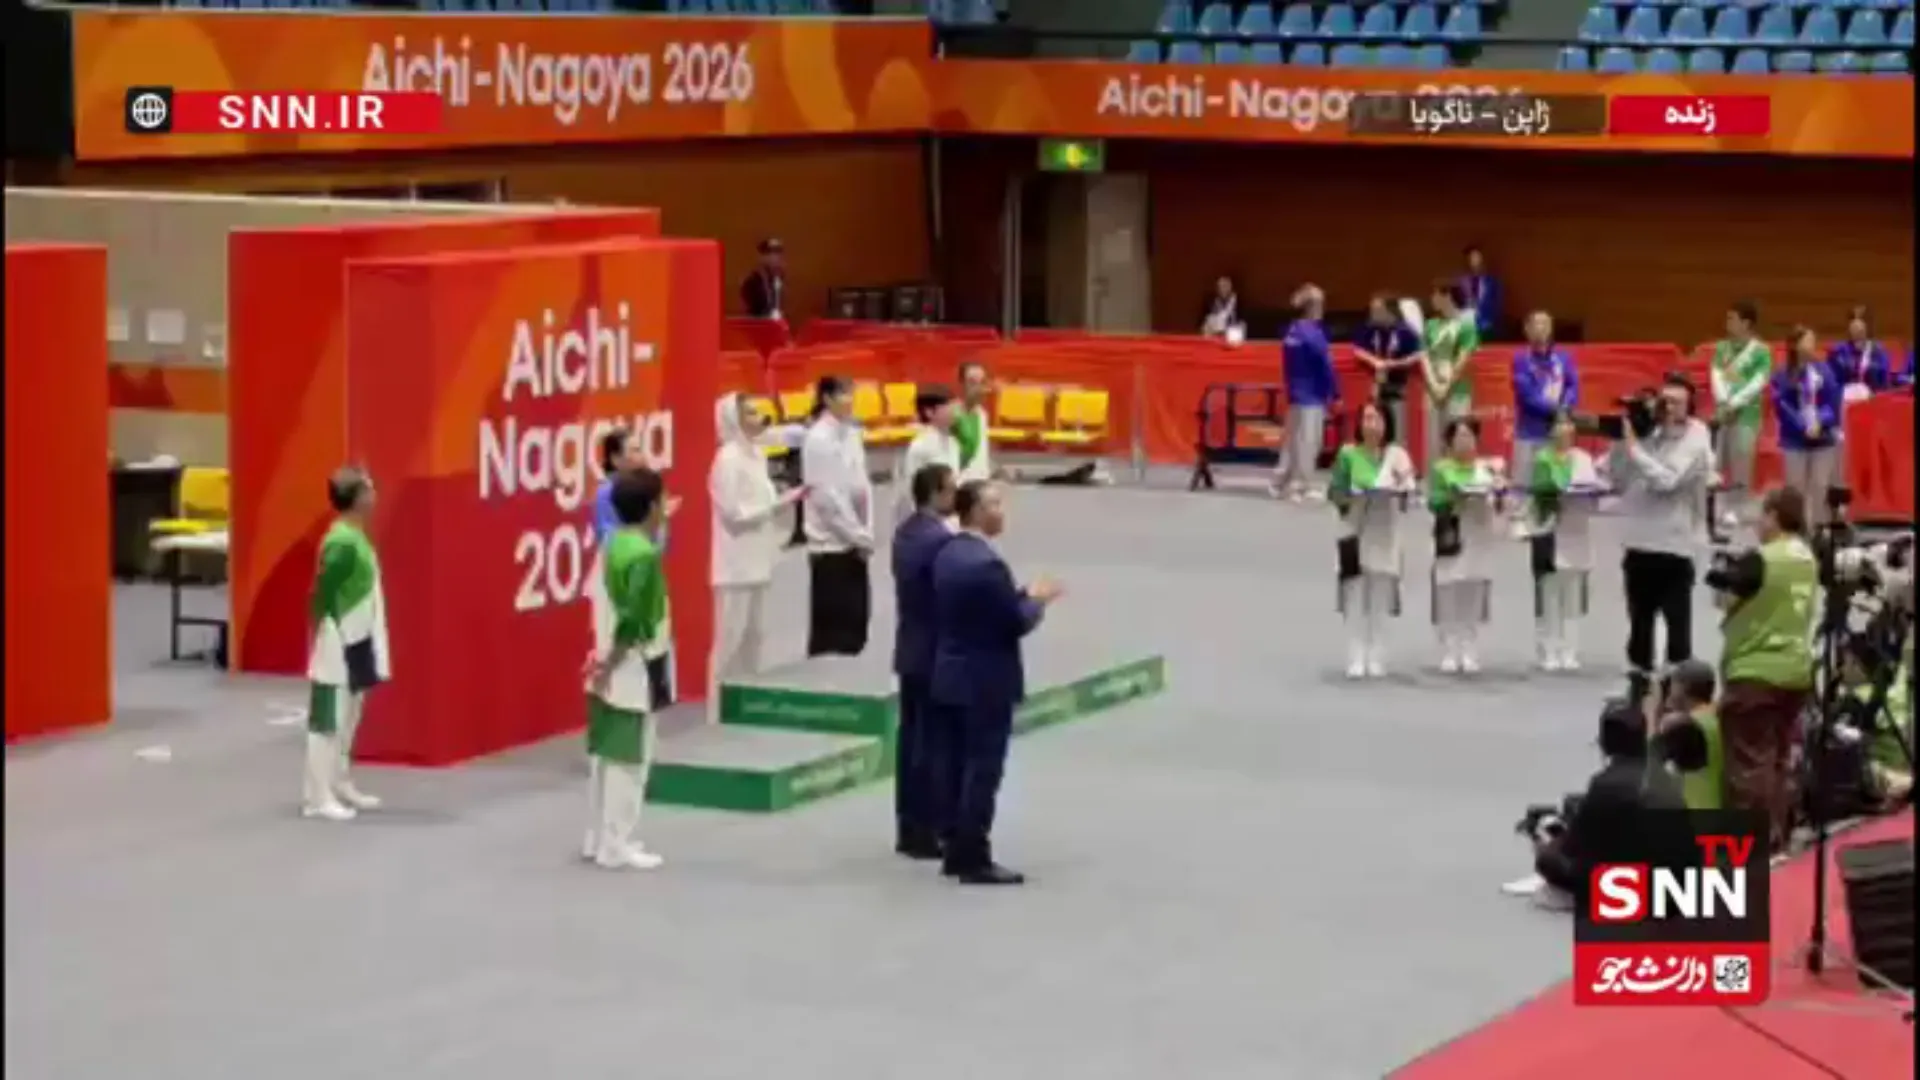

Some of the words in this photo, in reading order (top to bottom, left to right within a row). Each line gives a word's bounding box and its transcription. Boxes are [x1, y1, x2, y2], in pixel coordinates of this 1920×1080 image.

[362, 36, 651, 125] Aichi-Nagoya
[661, 42, 754, 102] 2026
[504, 301, 655, 402] Aichi-
[478, 409, 674, 511] Naga
